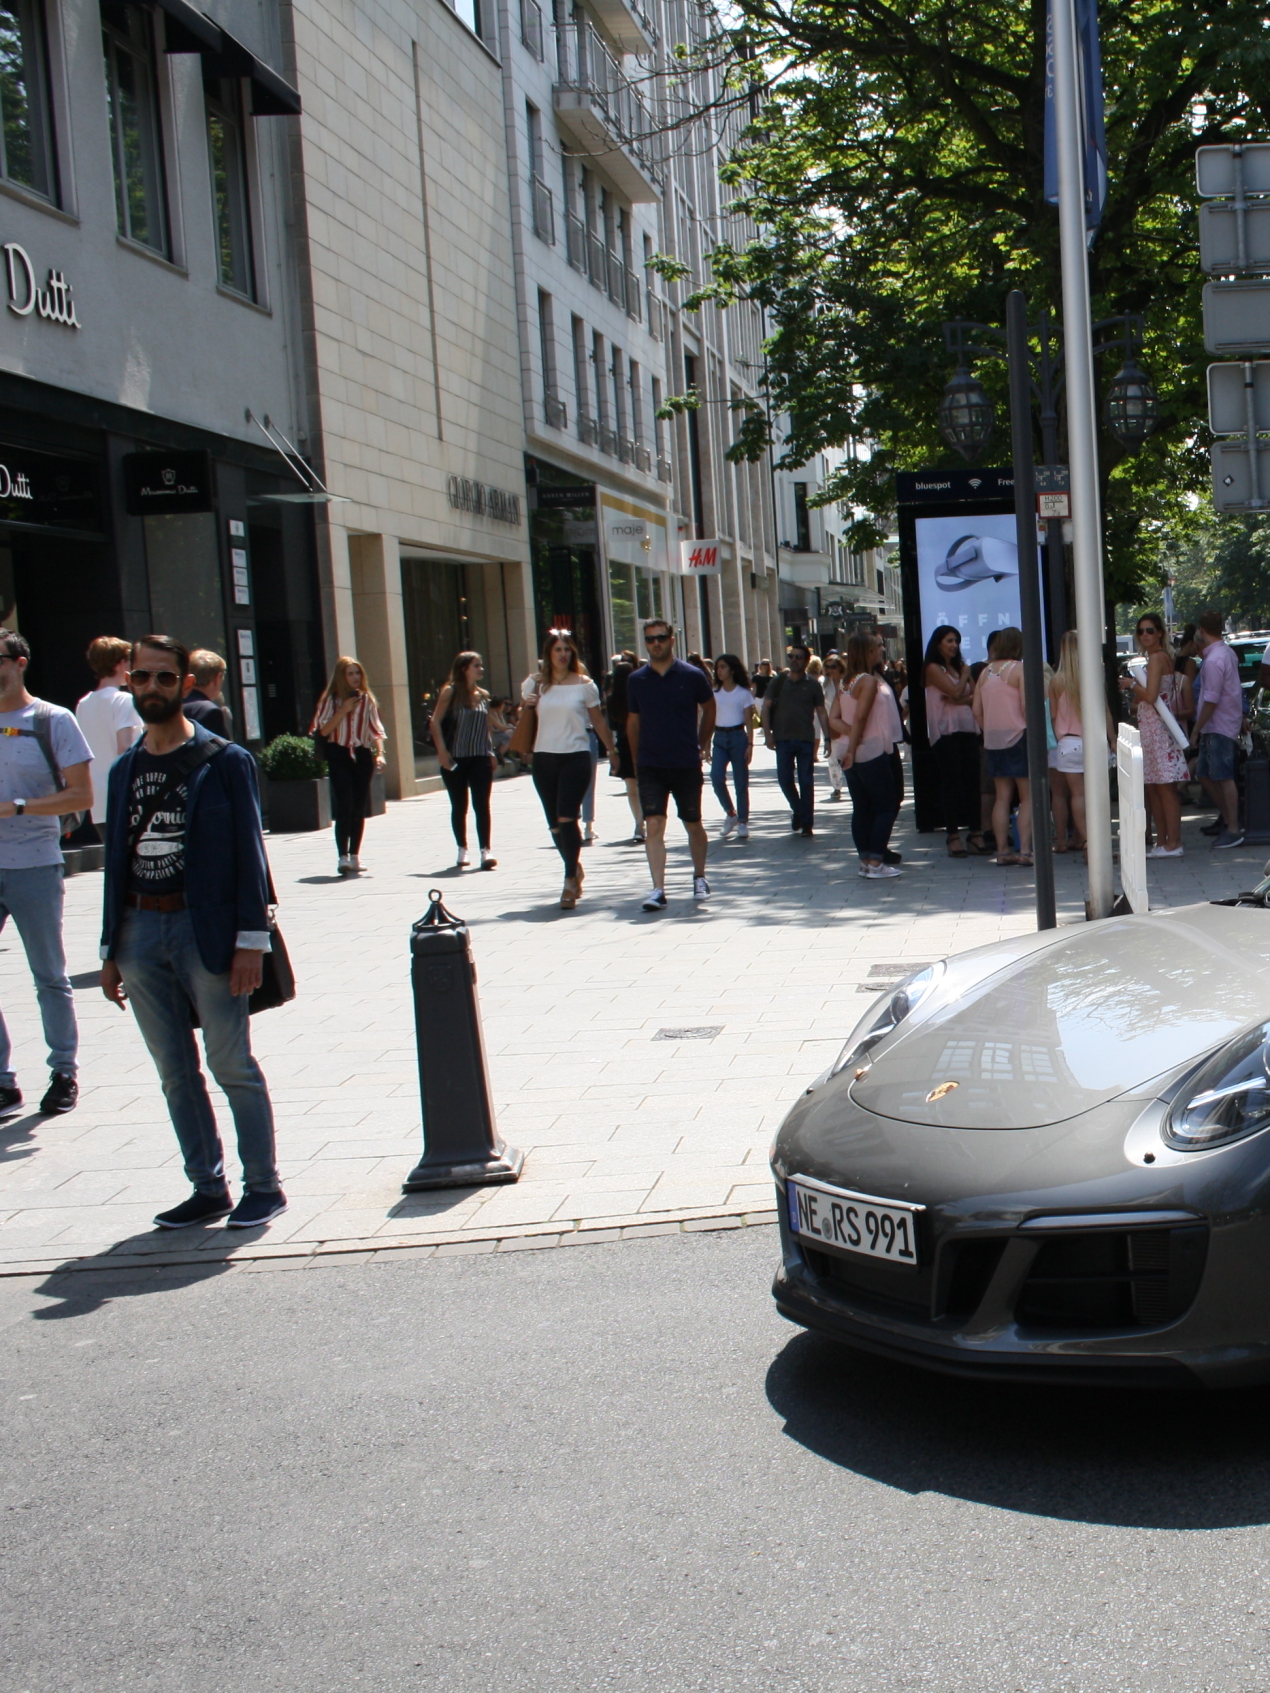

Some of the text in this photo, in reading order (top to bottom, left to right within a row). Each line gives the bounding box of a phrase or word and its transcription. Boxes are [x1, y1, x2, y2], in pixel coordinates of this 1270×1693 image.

[4, 243, 81, 328] Dutti
[0, 464, 33, 499] Dutti
[915, 481, 951, 491] bluespot
[612, 526, 644, 536] maje
[688, 547, 717, 568] H&M
[936, 612, 1011, 628] ÖFFN
[797, 1190, 914, 1259] NE RS 991
